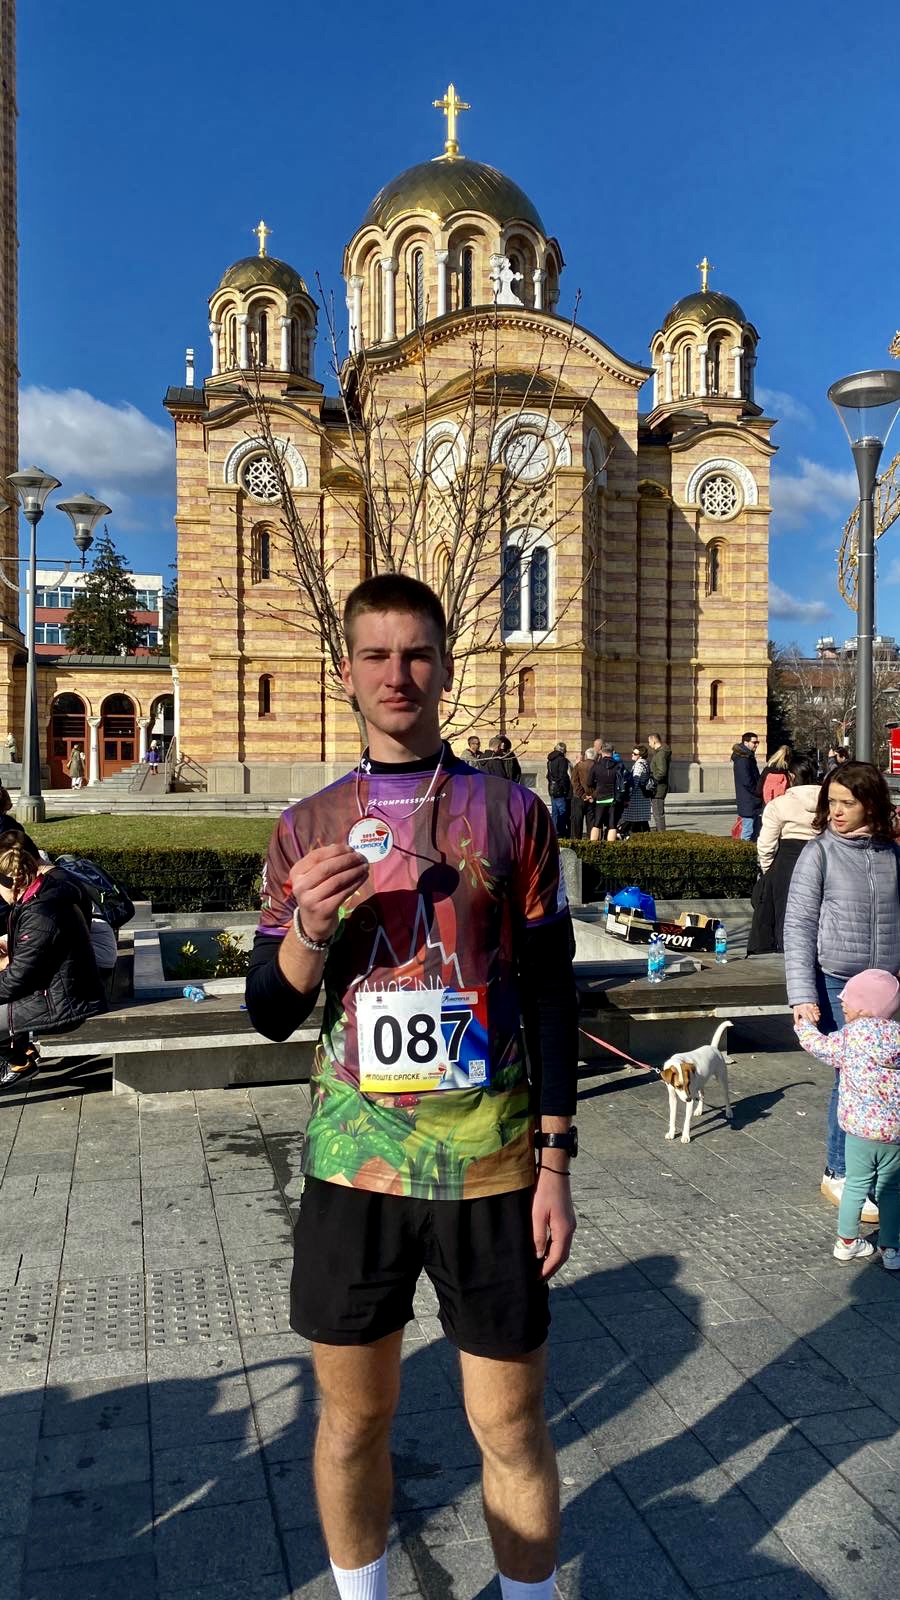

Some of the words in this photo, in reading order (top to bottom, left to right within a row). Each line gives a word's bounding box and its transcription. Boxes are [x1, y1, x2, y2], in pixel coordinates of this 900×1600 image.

[373, 1010, 473, 1065] 087
[371, 1073, 392, 1081] ПОШТЕ
[393, 1073, 420, 1081] СРПСКЕ
